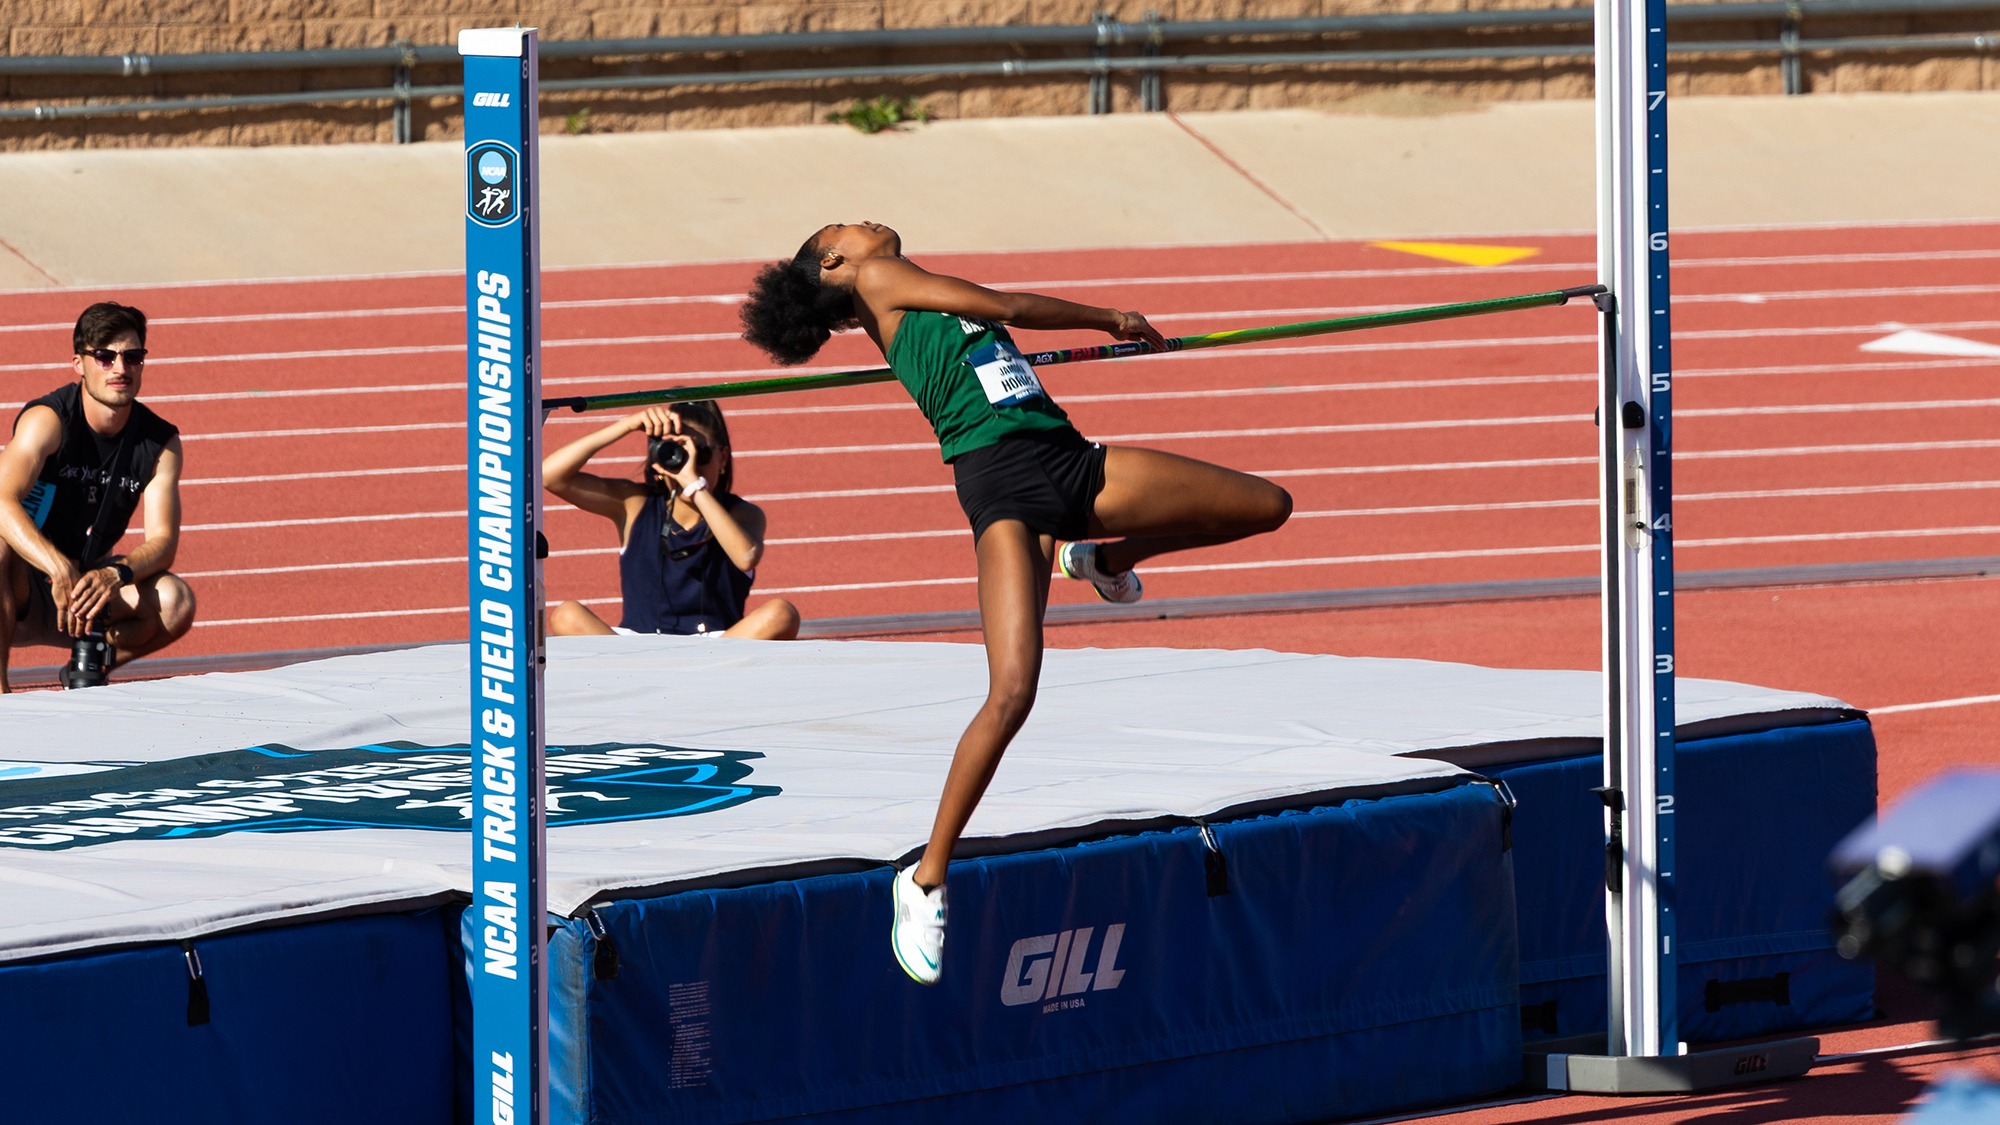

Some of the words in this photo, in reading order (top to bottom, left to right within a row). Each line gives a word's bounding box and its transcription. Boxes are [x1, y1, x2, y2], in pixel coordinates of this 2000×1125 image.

[521, 59, 529, 79] 8
[473, 92, 510, 107] GILL
[1647, 91, 1666, 111] 7
[481, 166, 507, 177] NCAA
[523, 207, 531, 227] 7
[1649, 232, 1668, 252] 6
[524, 353, 532, 375] 6
[1035, 353, 1053, 365] AGX
[1652, 372, 1671, 392] 5
[477, 270, 513, 592] CHAMPIONSHIPS
[525, 502, 533, 523] 5
[1653, 513, 1673, 532] 4
[480, 598, 514, 704] FIELD
[527, 649, 535, 669] 4
[1655, 654, 1674, 674] 3
[482, 708, 515, 738] &
[481, 740, 516, 862] TRACK
[530, 797, 537, 818] 3
[1656, 795, 1675, 814] 2
[484, 881, 517, 980] NCAA
[1664, 936, 1670, 955] 1
[1000, 923, 1126, 1007] GILL
[1042, 1002, 1060, 1014] MADE
[1061, 1001, 1068, 1011] IN
[1069, 998, 1085, 1009] USA
[491, 1050, 515, 1125] GILL
